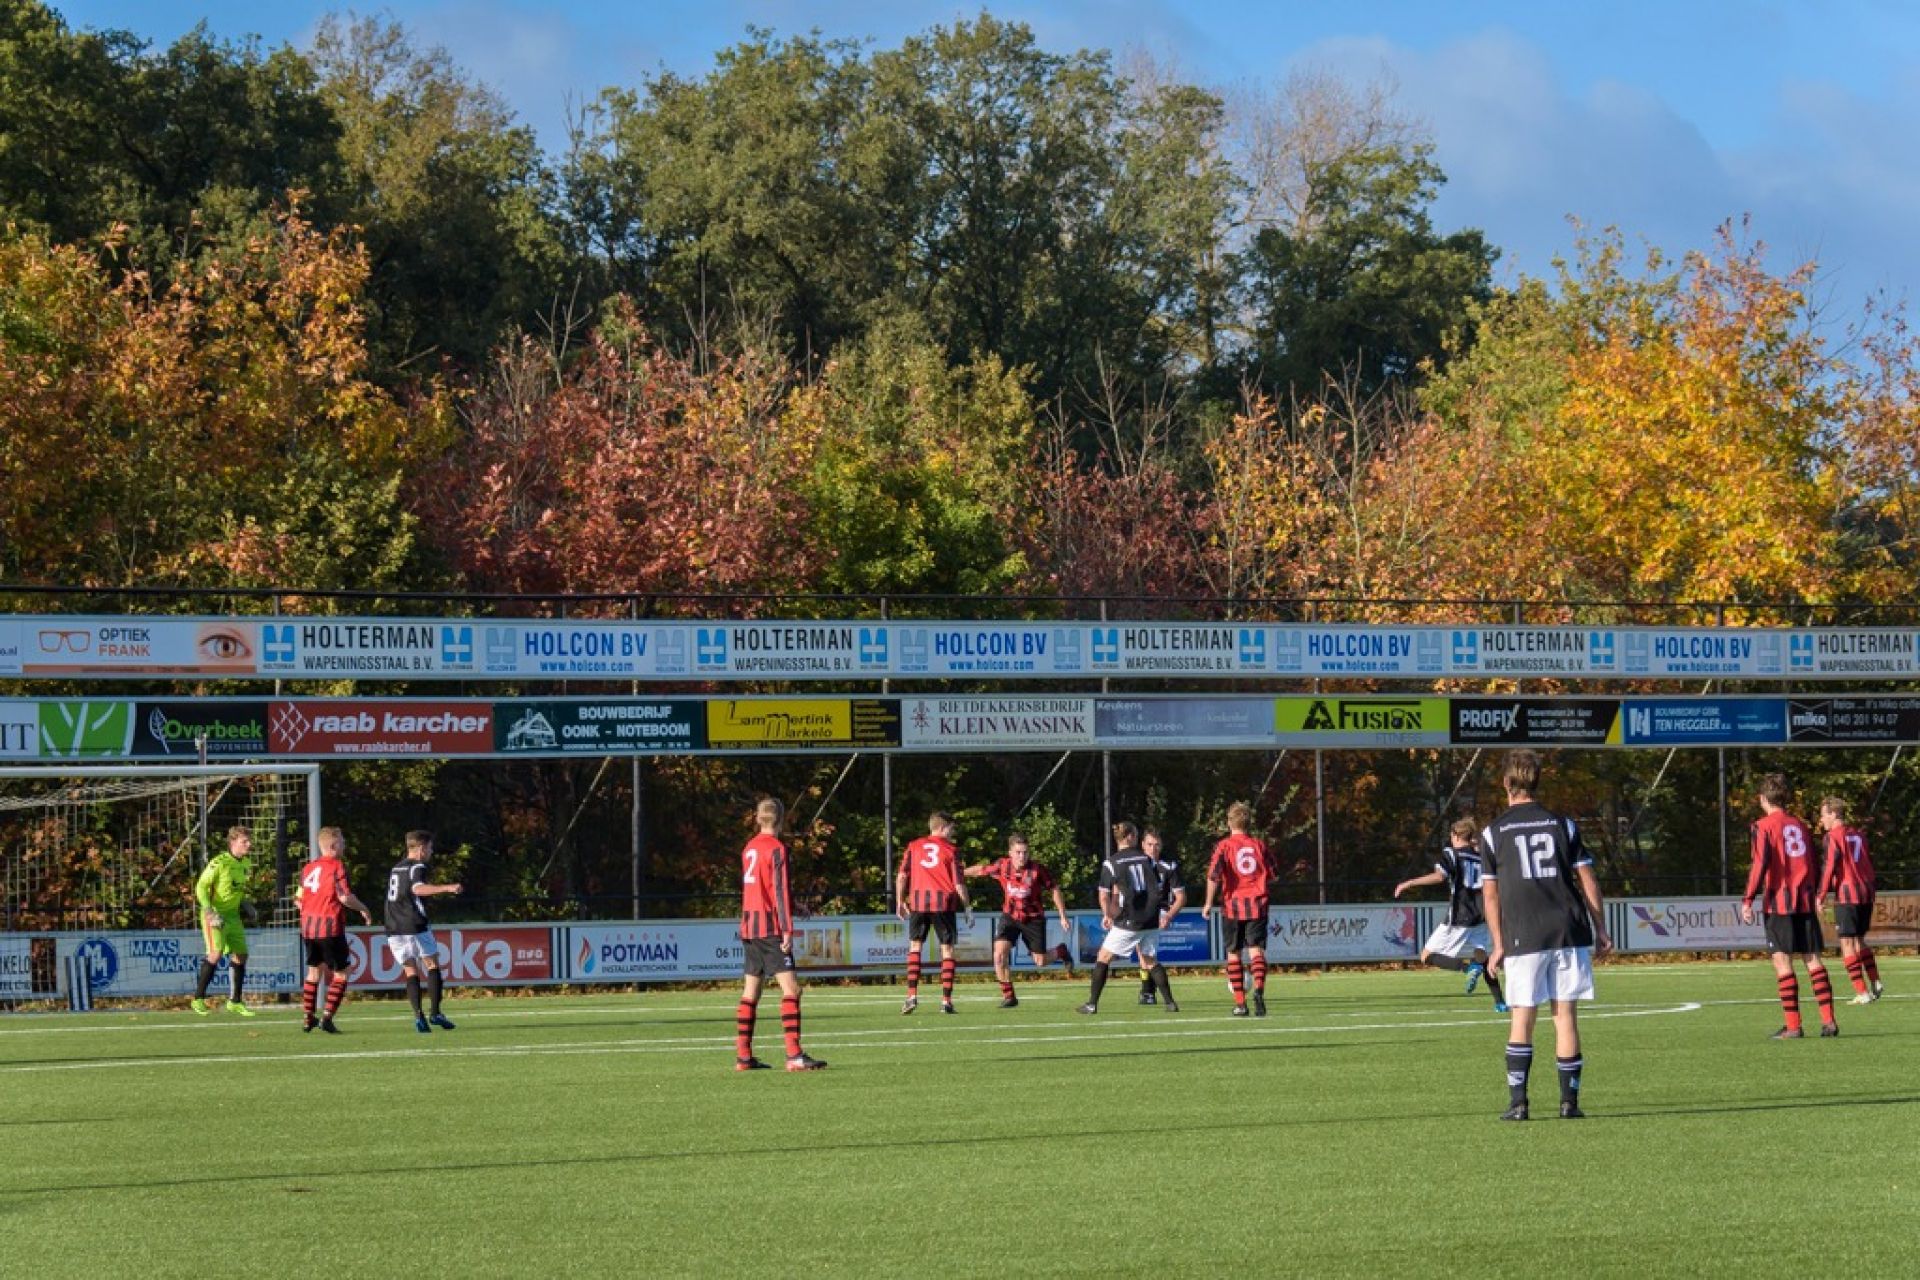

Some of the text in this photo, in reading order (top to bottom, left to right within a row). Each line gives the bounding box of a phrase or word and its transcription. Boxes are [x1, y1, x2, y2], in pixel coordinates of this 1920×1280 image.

[99, 627, 150, 641] OPTIEK
[303, 625, 434, 649] HOLTERMAN
[525, 631, 648, 656] HOLCON BV
[733, 628, 852, 650] HOLTERMAN
[1124, 629, 1233, 650] HOLTERMAN
[1483, 631, 1585, 652] HOLTERMAN
[1819, 634, 1912, 653] HOLTERMAN
[99, 644, 150, 657] FRANK
[935, 633, 1047, 655] HOLCON BV
[1309, 634, 1411, 656] HOLCON BV
[1655, 637, 1751, 658] HOLCON BV
[304, 656, 409, 670] WAPENINGSSTAAL
[413, 656, 434, 670] B.V.
[540, 660, 634, 672] www.holcon.com
[735, 657, 831, 671] WAPENINGSSTAAL
[834, 657, 853, 671] B.V.
[949, 660, 1034, 670] www.holcon.com
[1125, 657, 1214, 670] WAPENINGSSTAAL
[1216, 657, 1232, 670] B.V.
[1321, 660, 1399, 671] www.holcon.com
[1484, 658, 1565, 671] WAPENINGSSTAAL
[1569, 658, 1585, 671] B.V.
[1667, 662, 1740, 672] www.holcon.com
[1820, 660, 1894, 672] WAPENINGSSTAAL
[579, 705, 671, 720] BOUWBEDRIJF
[938, 700, 1085, 713] RIETDEKKERSBEDRIJF
[1096, 702, 1142, 711] Keukens
[313, 712, 488, 733] raab karcher
[940, 717, 1085, 734] KLEIN WASSINK
[1459, 703, 1520, 732] PROFIX
[1655, 718, 1673, 731] TEN
[165, 719, 263, 739] Overbeek
[562, 725, 600, 738] OONK
[617, 724, 690, 737] NOTEBOOM
[334, 742, 431, 752] www.raabkarcher.nl
[1783, 825, 1806, 857] 8
[1846, 835, 1862, 862] 7
[920, 843, 939, 868] 3
[1235, 847, 1257, 875] 6
[1515, 833, 1557, 879] 12
[743, 849, 758, 884] 2
[304, 866, 322, 892] 4
[1128, 863, 1147, 891] 11
[388, 874, 398, 900] 8
[1290, 918, 1369, 938] VREEKAMP
[129, 940, 178, 956] MAAS
[602, 944, 678, 962] POTMAN
[716, 948, 729, 958] 06
